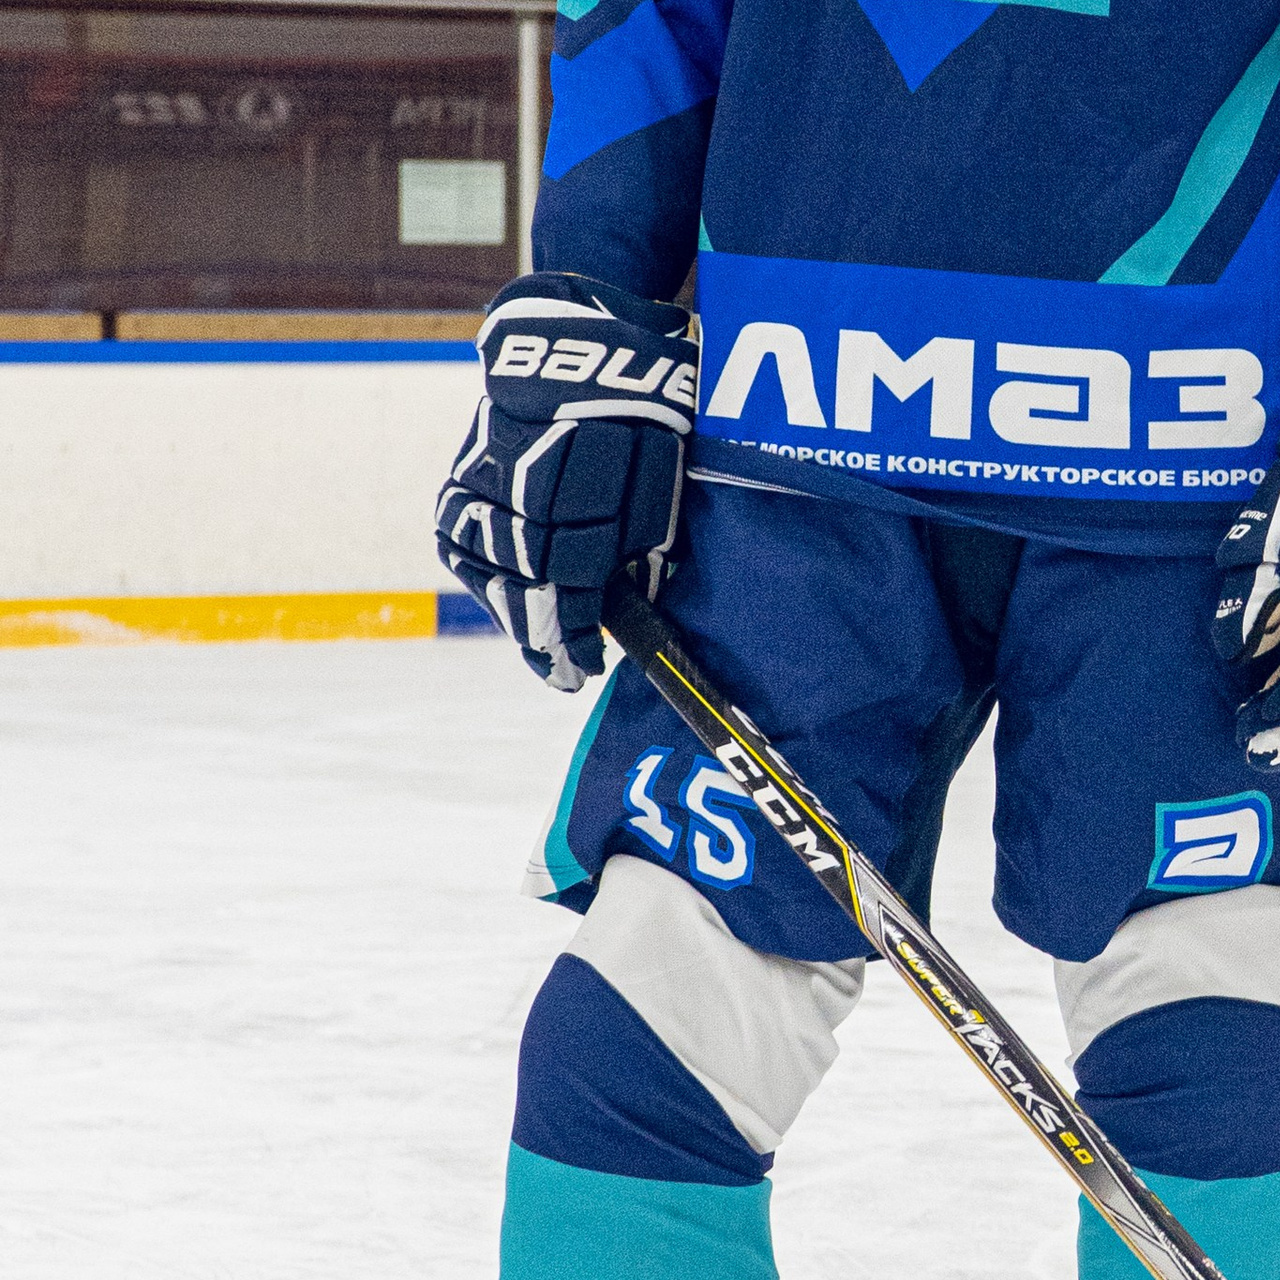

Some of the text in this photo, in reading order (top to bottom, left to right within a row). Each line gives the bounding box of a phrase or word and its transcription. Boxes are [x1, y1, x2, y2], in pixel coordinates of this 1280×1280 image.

[886, 453, 1176, 487] КОНСТРУКТОРСКОЕ
[1182, 467, 1267, 487] БЮРО
[628, 753, 750, 883] 15
[715, 736, 842, 874] CCM
